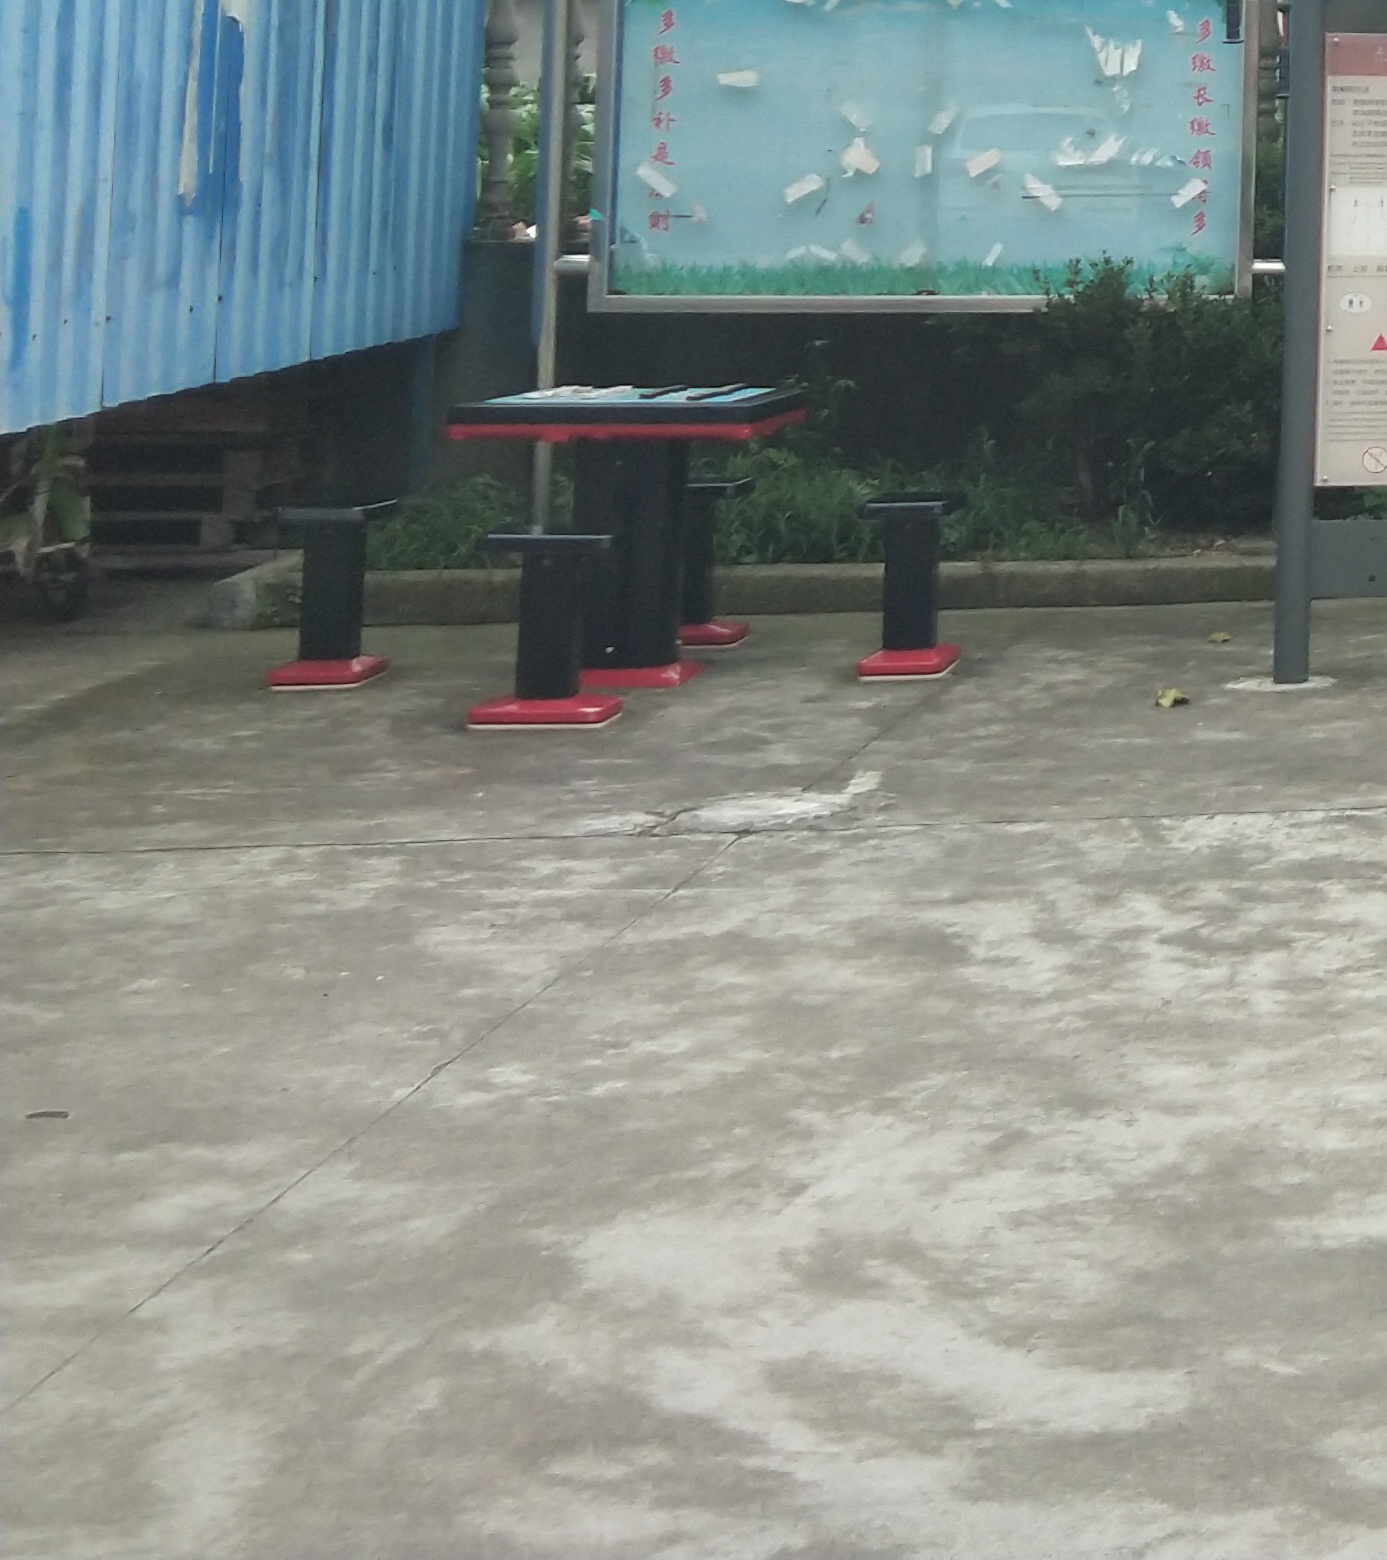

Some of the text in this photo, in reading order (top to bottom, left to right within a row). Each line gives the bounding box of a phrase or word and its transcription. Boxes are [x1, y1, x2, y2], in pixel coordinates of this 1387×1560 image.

[649, 9, 681, 231] 多缴多补是则
